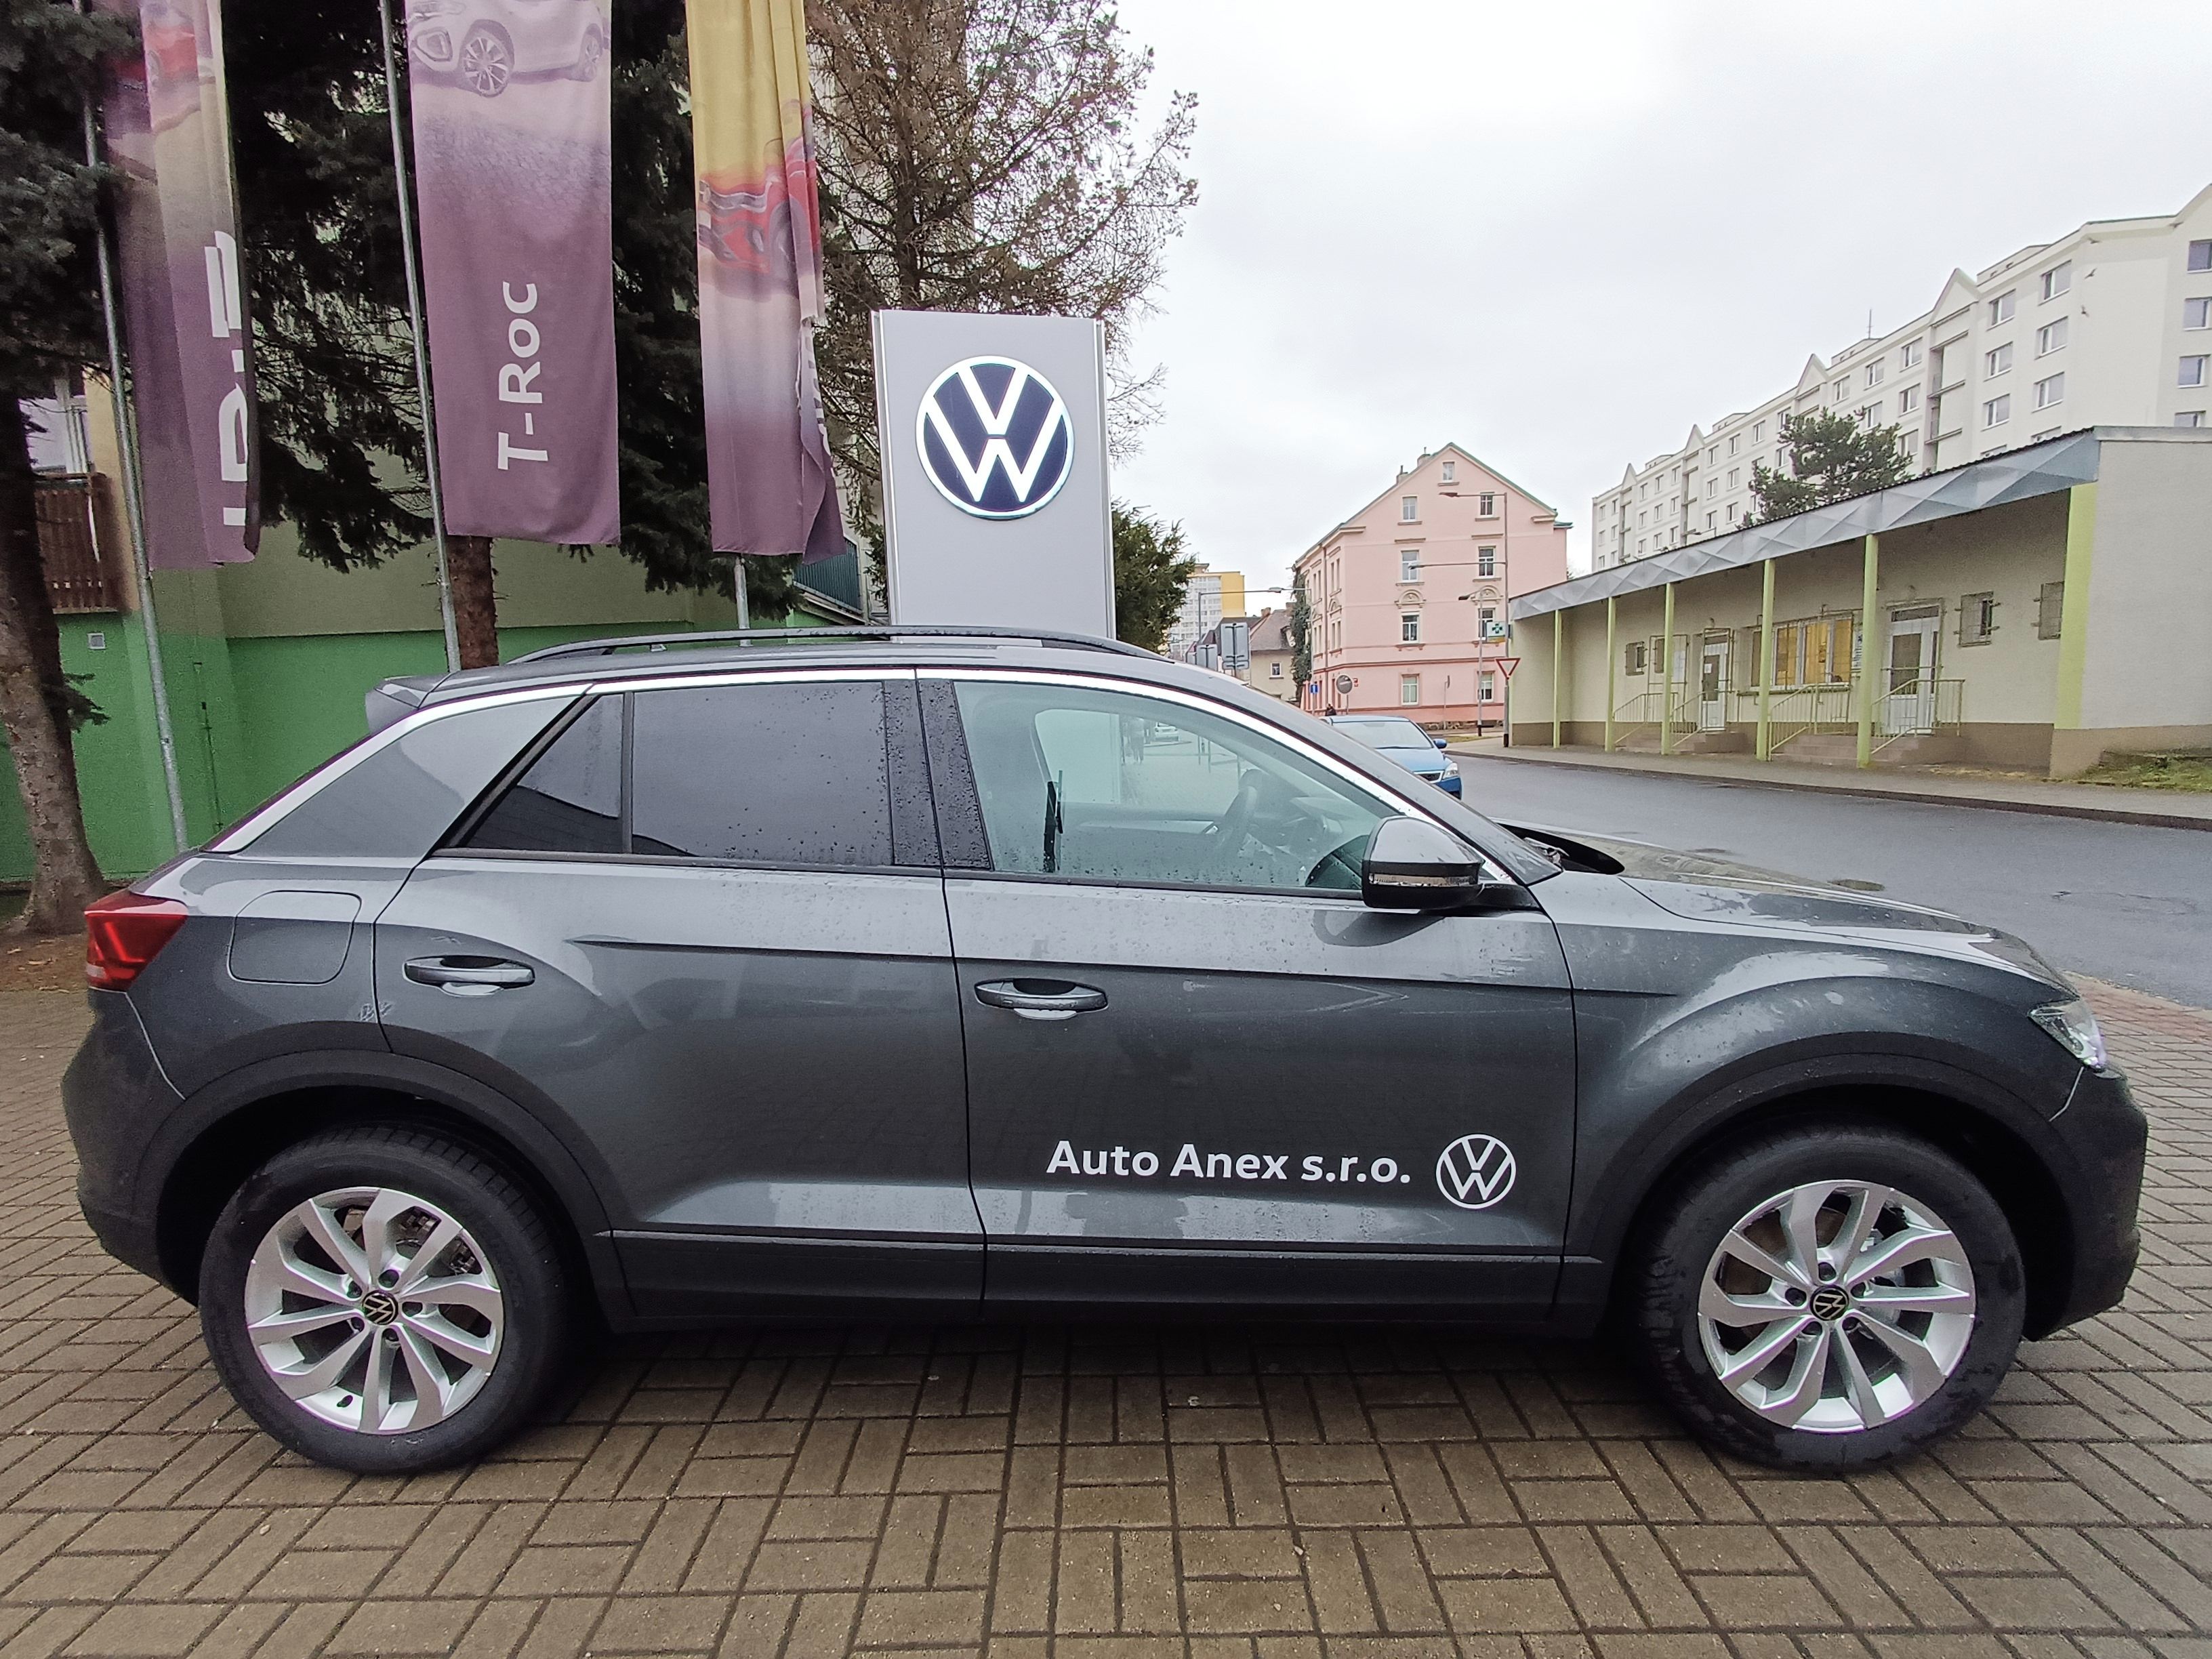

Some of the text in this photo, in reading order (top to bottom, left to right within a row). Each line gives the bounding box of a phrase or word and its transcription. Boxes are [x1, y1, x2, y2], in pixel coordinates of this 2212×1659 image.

[497, 281, 548, 470] T-Roc
[1046, 1140, 1411, 1184] Auto Anex s.r.o.
